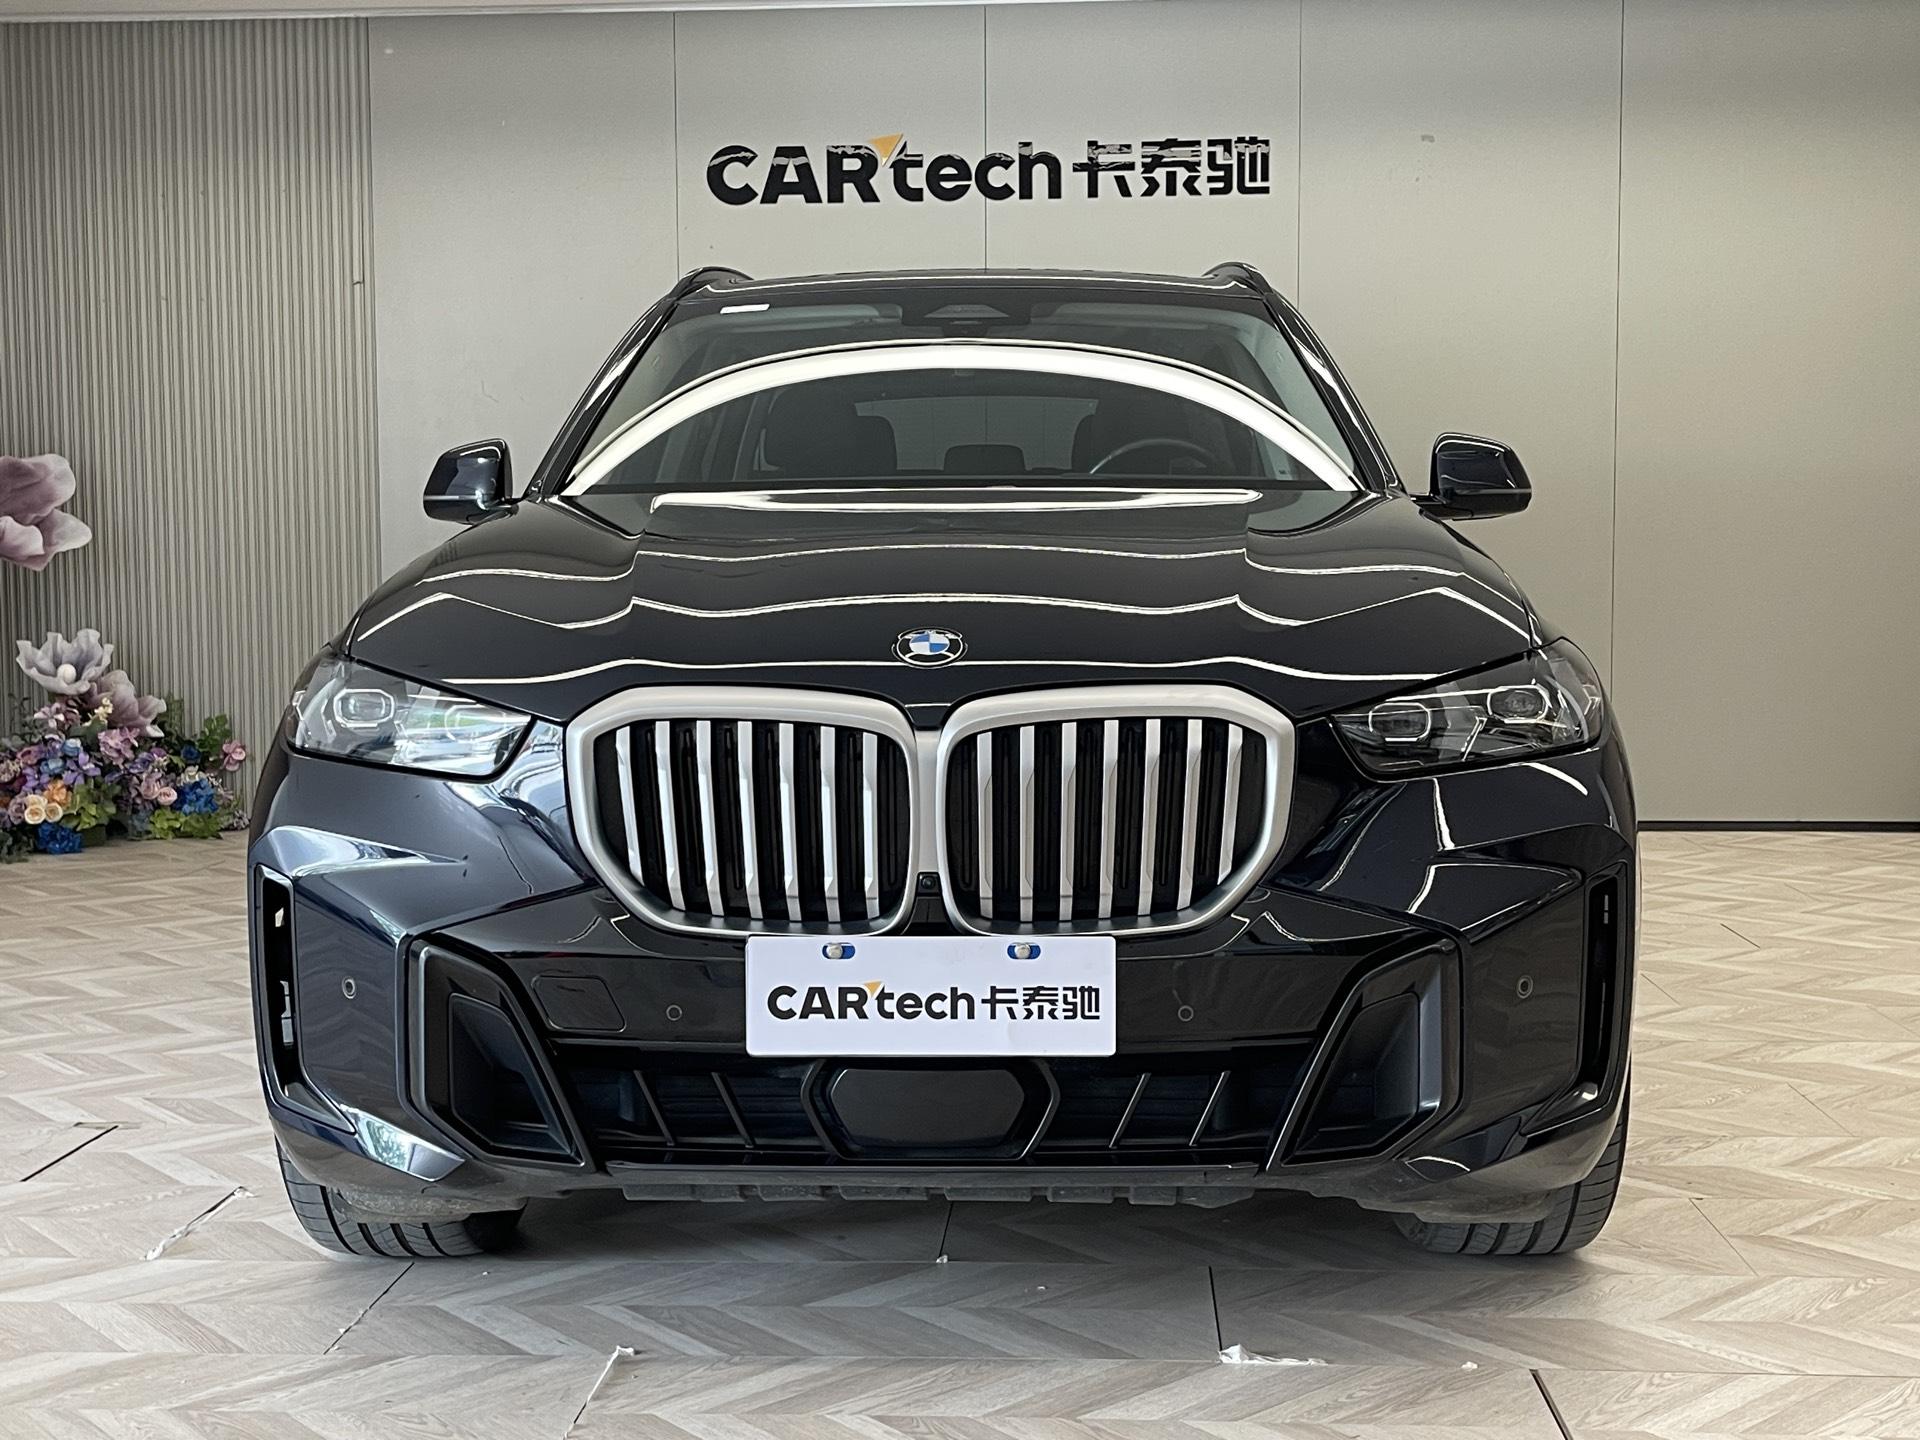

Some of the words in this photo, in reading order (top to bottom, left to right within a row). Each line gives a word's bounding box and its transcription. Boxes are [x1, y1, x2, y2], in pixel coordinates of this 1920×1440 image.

[706, 140, 1062, 205] CARtech
[1072, 136, 1270, 198] 卡泰驰
[767, 985, 975, 1020] CARtech
[981, 985, 1100, 1020] 卡泰驰
